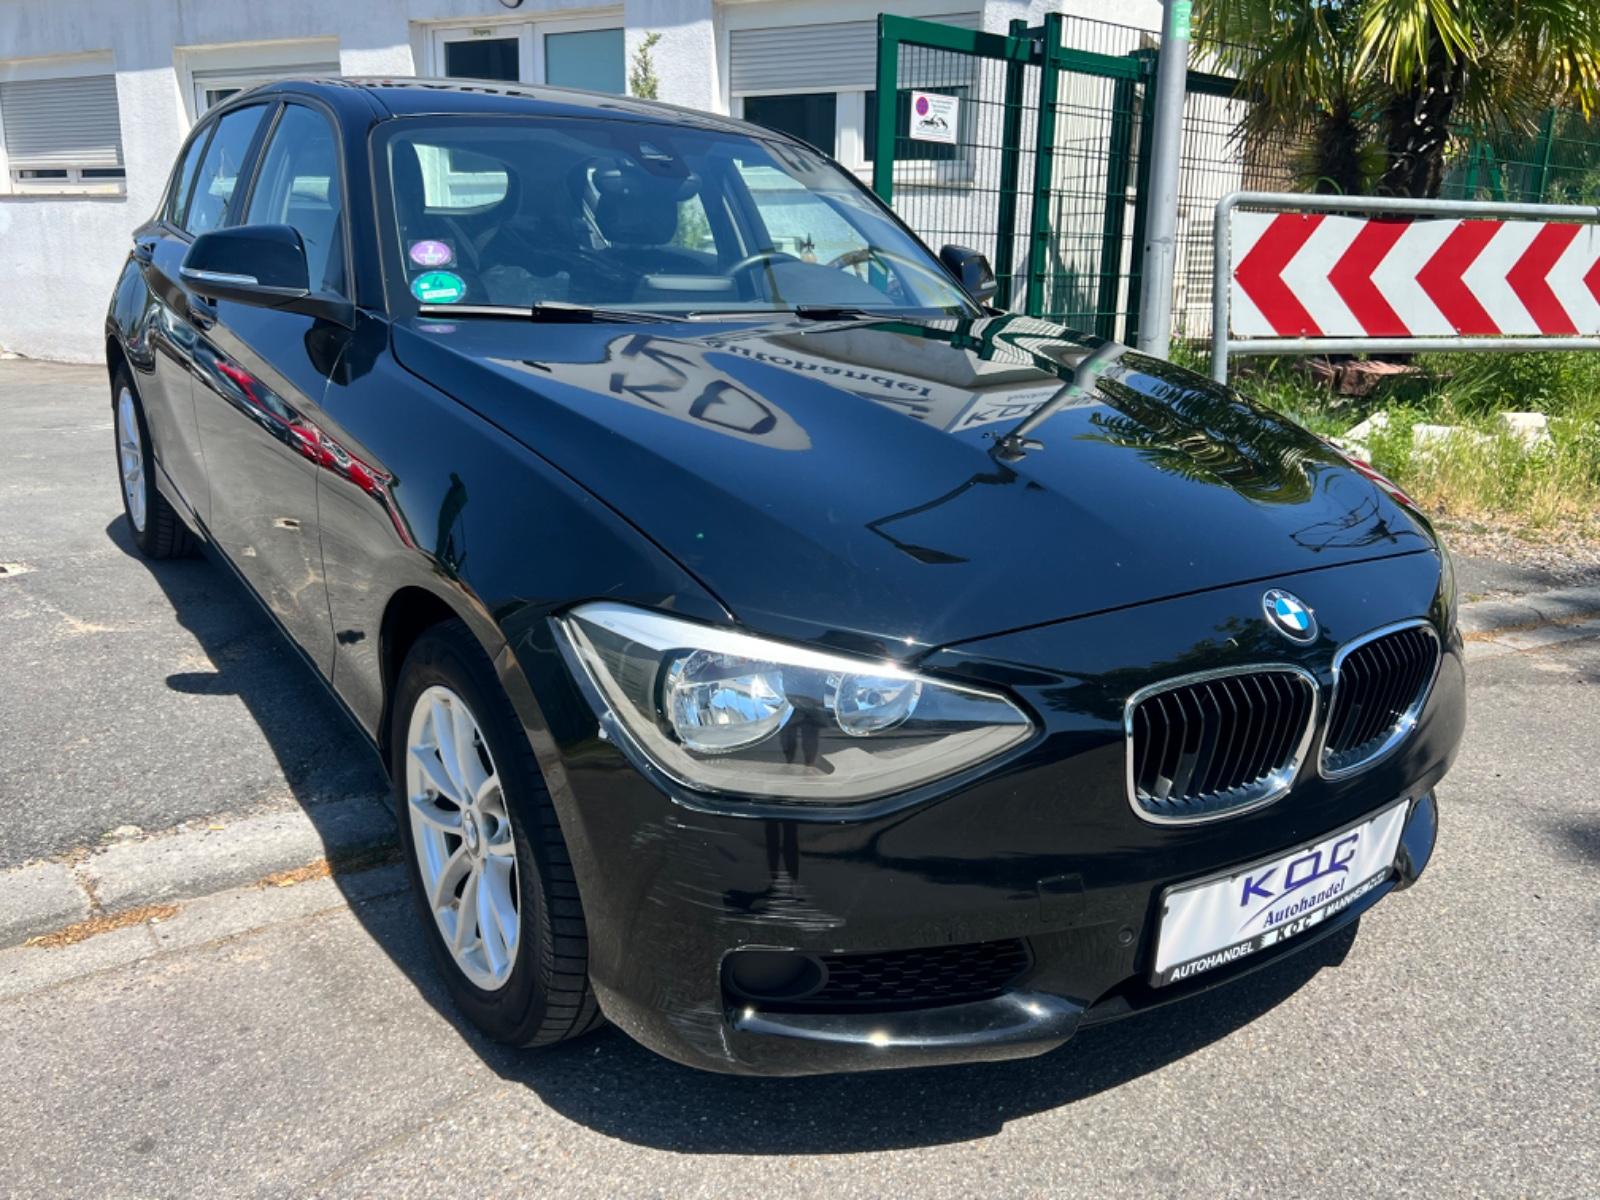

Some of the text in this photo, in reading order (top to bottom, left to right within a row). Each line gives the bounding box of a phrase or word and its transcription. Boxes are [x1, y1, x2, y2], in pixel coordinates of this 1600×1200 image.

[431, 275, 445, 288] 4
[1263, 877, 1346, 929] Autohandel
[1169, 942, 1255, 983] AUTOHANDEL
